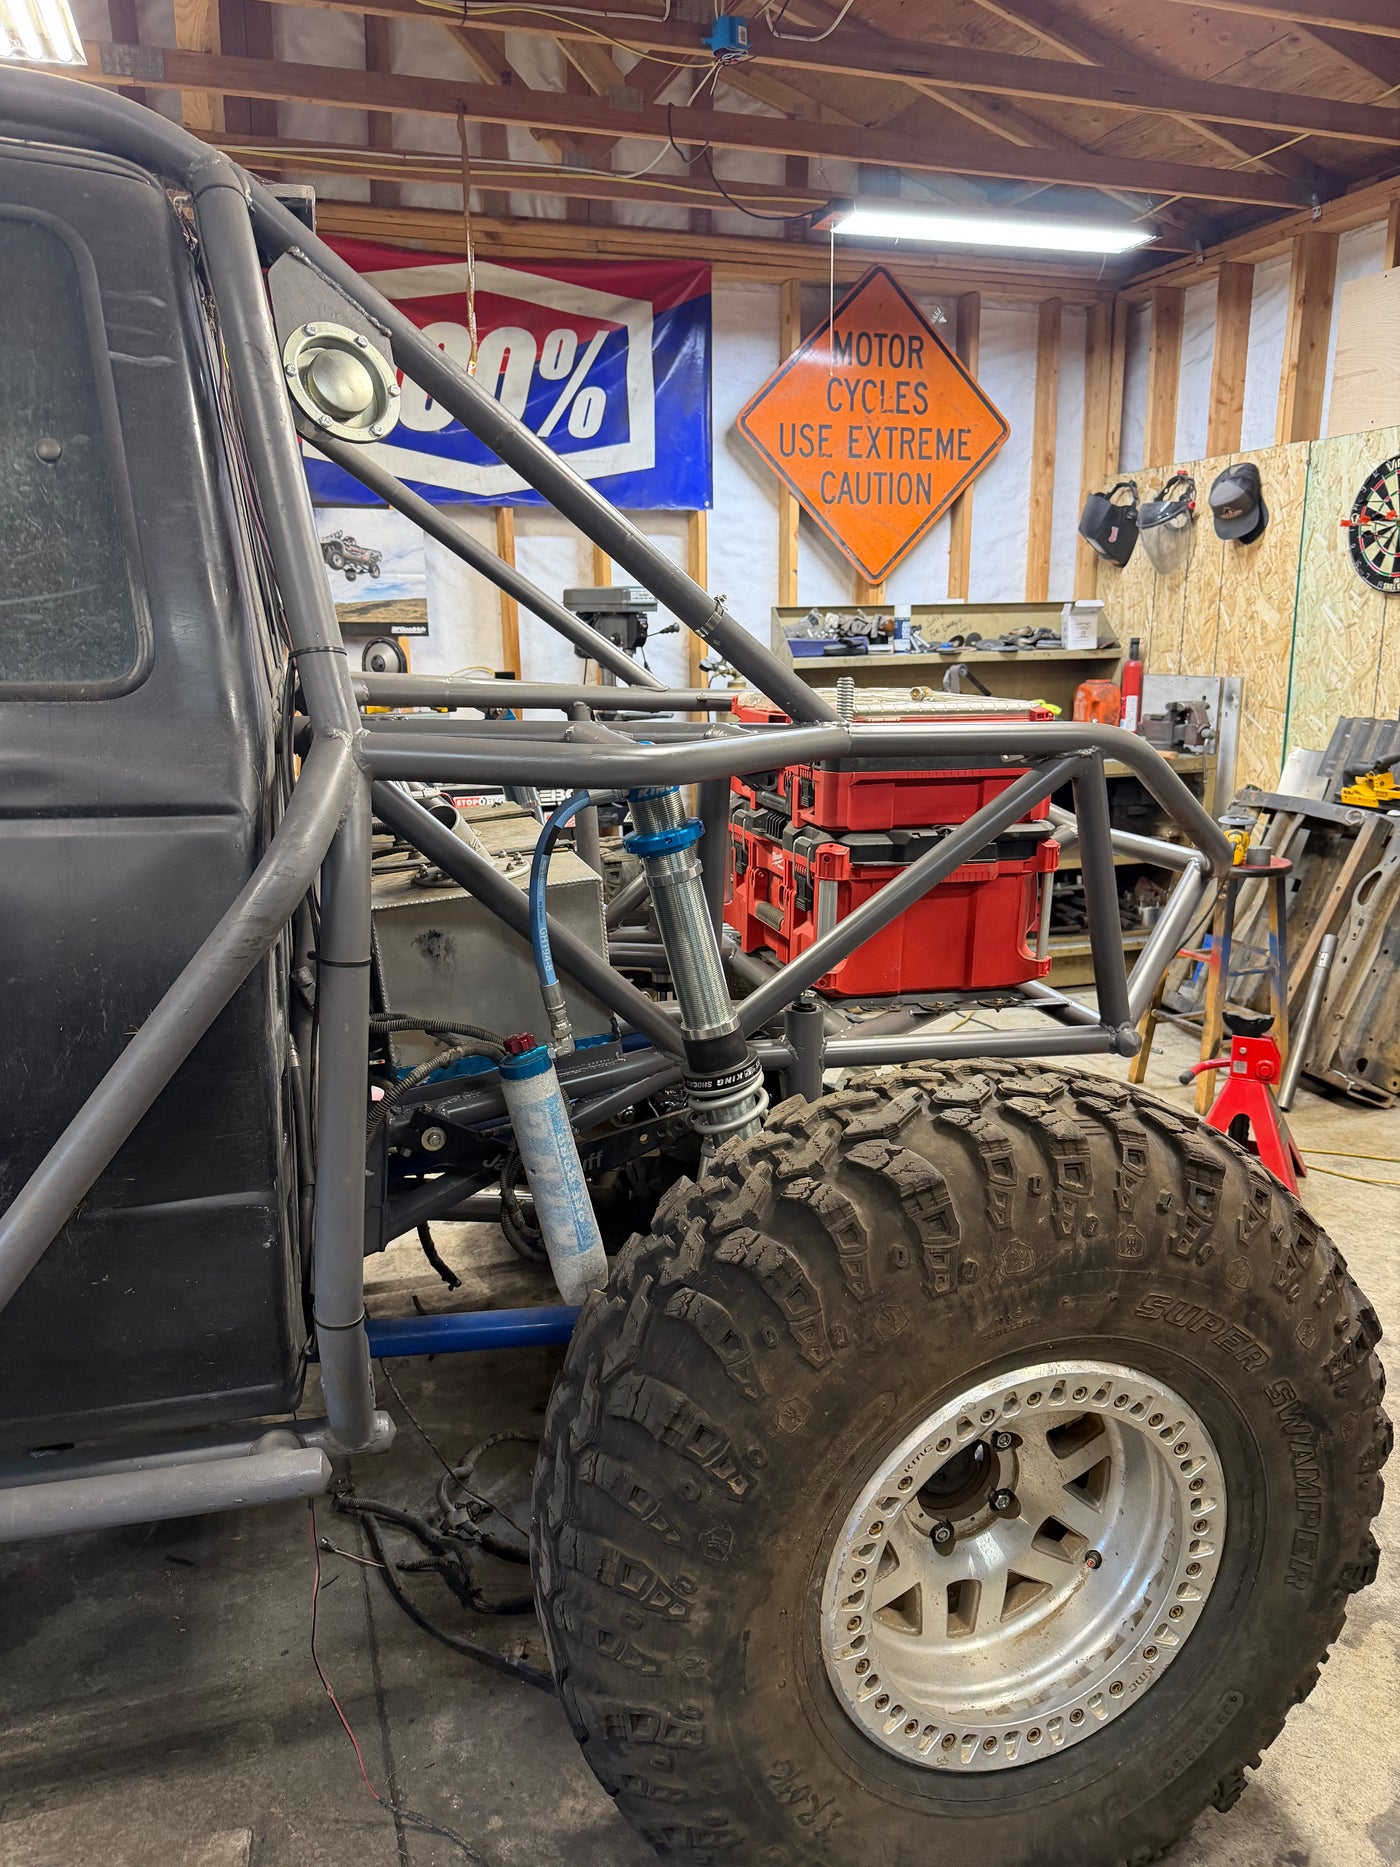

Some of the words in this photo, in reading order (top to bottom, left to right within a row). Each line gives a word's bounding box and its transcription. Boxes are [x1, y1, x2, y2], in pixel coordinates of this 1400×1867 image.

[833, 330, 924, 369] MOTOR
[827, 377, 928, 415] CYCLES
[779, 422, 833, 458] USE
[848, 425, 972, 461] EXTREME
[820, 470, 932, 505] CAUTION
[456, 799, 479, 807] STOP
[717, 1072, 744, 1086] KING
[1135, 1293, 1271, 1372] SUPER
[1263, 1379, 1323, 1591] SWAMPER
